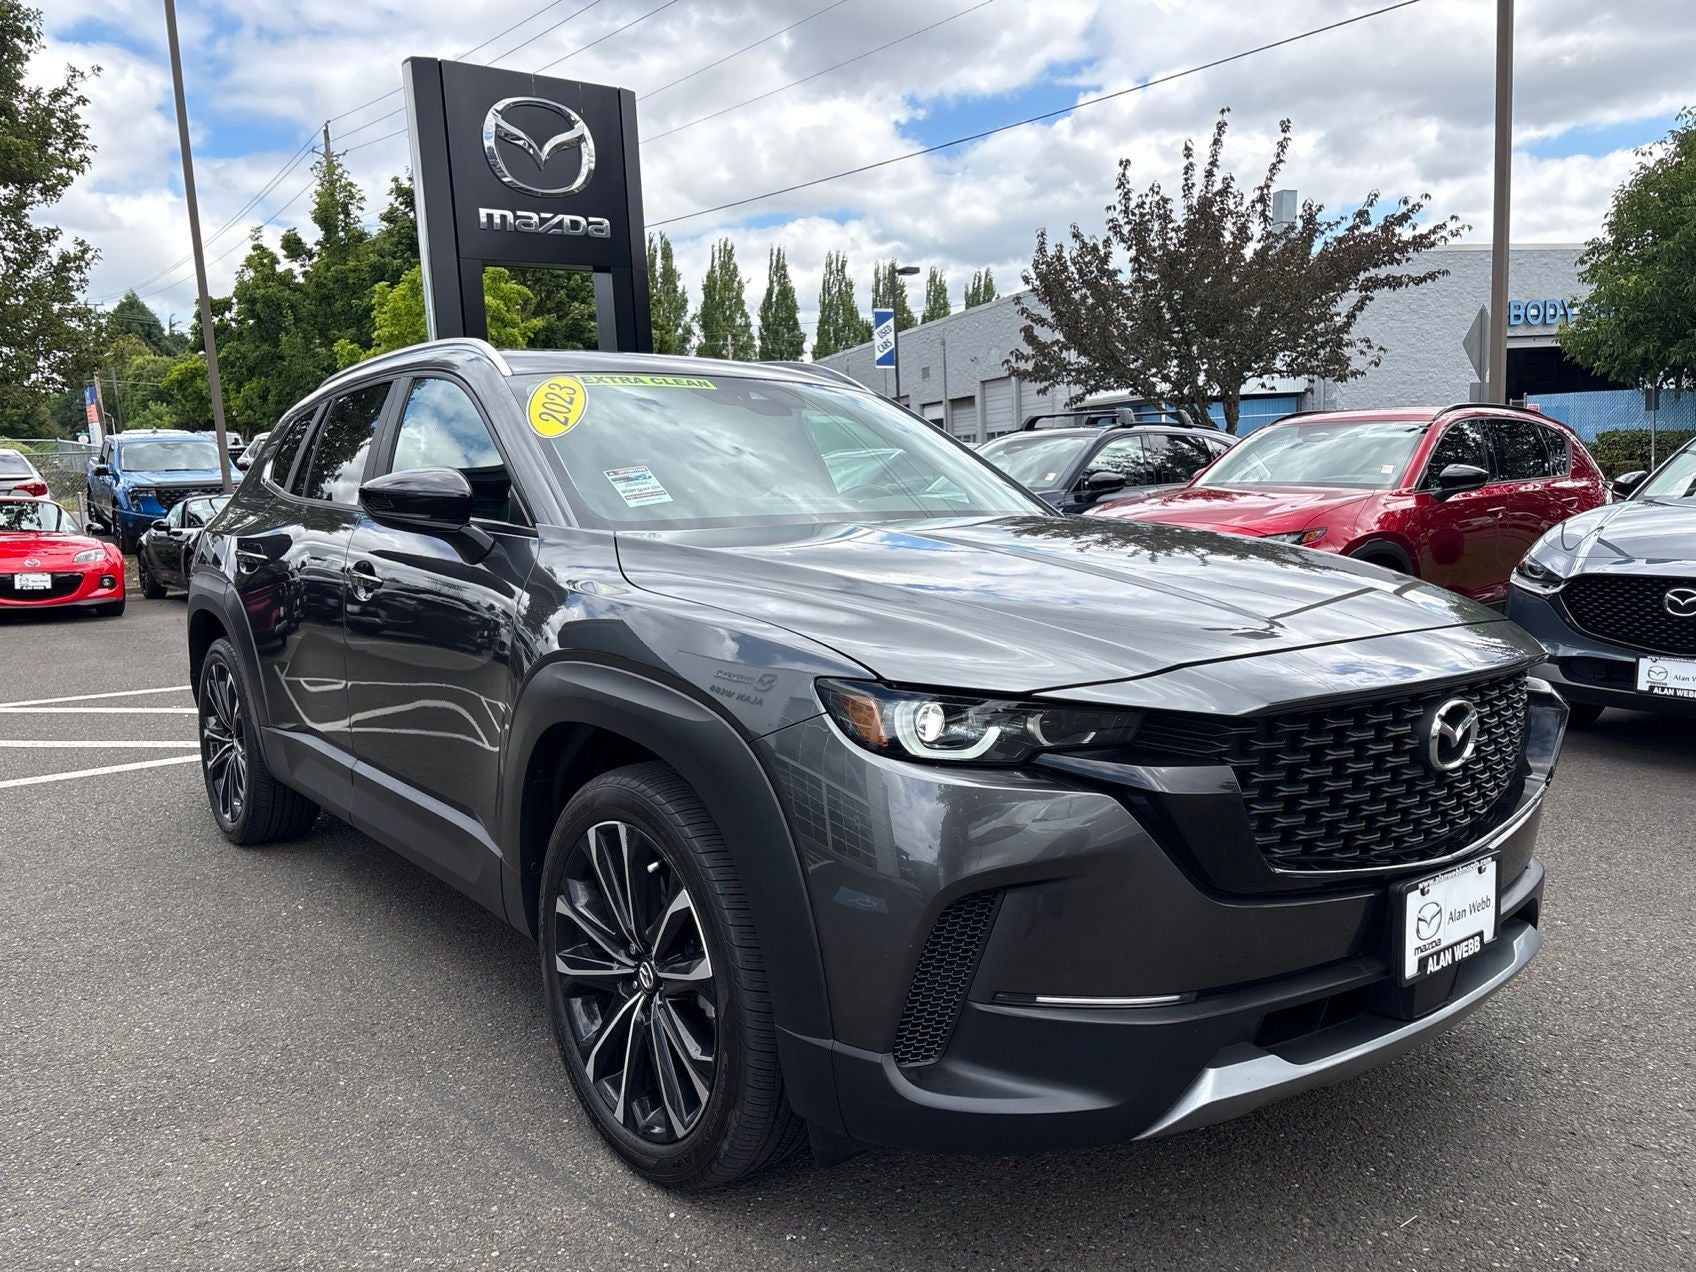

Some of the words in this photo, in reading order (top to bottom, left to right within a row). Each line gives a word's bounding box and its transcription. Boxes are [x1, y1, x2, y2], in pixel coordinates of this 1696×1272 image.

[877, 324, 893, 339] USED
[877, 339, 893, 353] CARS
[581, 376, 645, 384] EXTRA
[649, 377, 711, 387] CLEAN
[538, 382, 577, 427] 2023
[1673, 674, 1690, 682] Alan
[1653, 686, 1674, 696] ALAN
[1676, 688, 1696, 698] WEB
[1447, 909, 1467, 925] Alan
[1469, 895, 1491, 914] Webb
[1426, 947, 1452, 975] ALAN
[1453, 936, 1481, 962] WEBB
